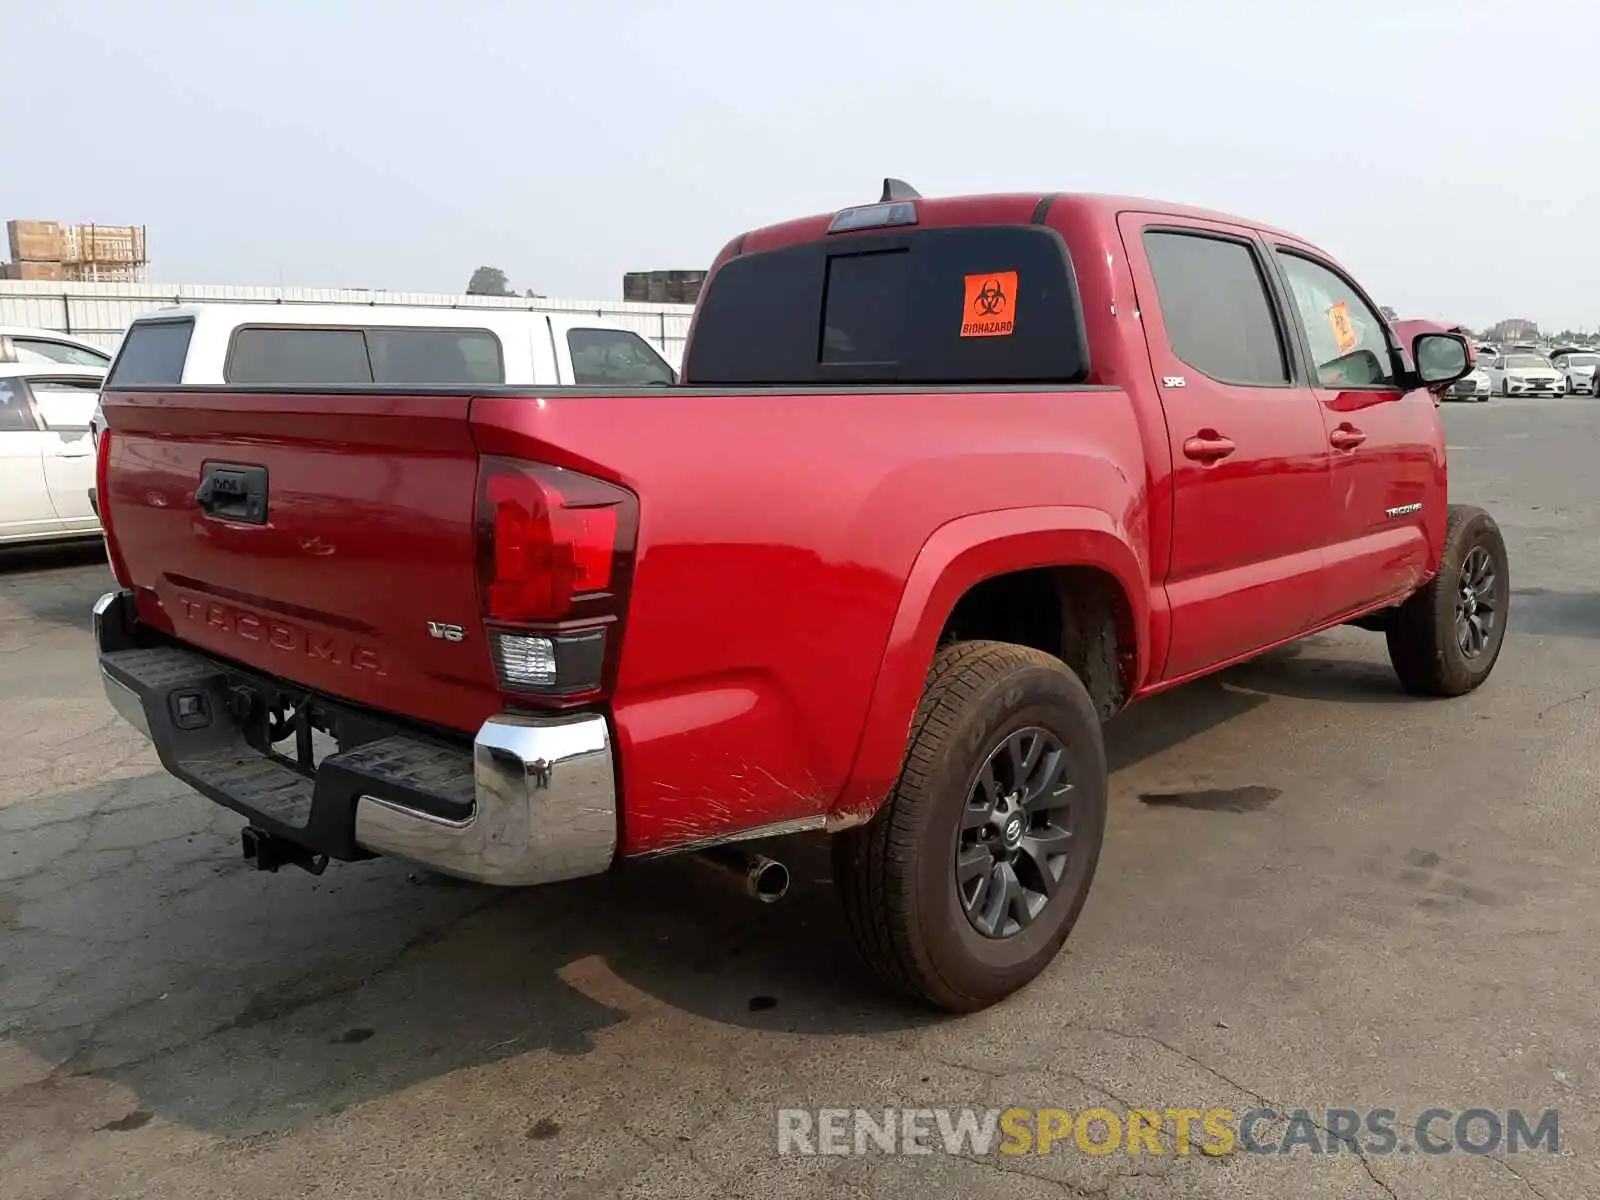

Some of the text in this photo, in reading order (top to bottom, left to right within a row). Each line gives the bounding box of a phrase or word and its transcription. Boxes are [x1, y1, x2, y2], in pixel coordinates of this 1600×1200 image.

[962, 321, 1013, 334] BIOHAZARD
[180, 599, 388, 677] TACOMA
[426, 620, 466, 643] V6
